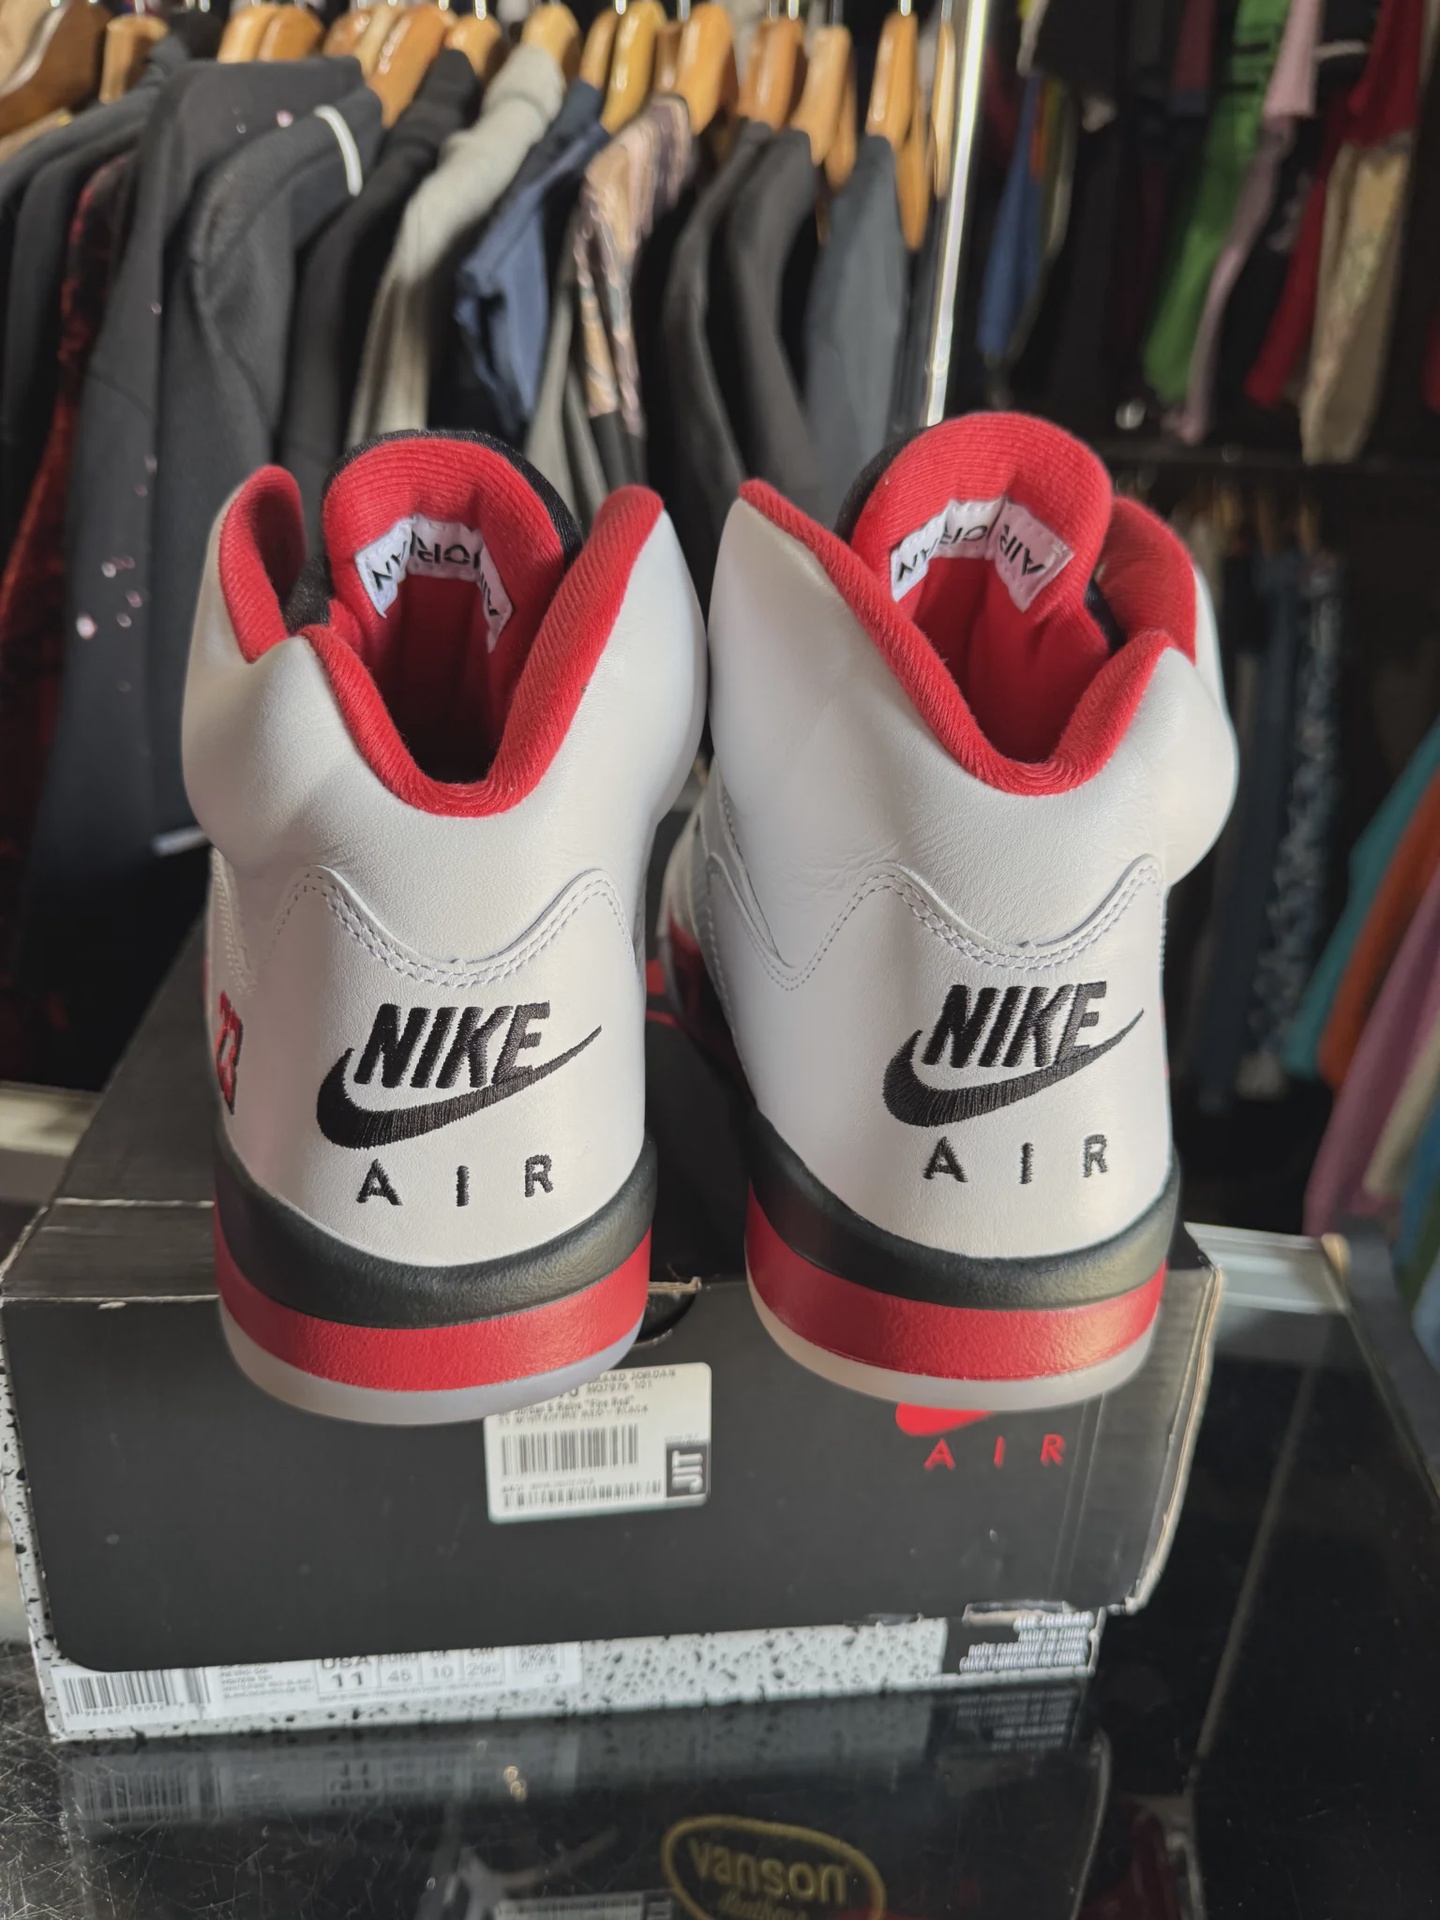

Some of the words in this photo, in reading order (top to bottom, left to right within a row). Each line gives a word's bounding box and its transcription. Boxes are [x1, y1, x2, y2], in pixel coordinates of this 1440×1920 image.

[354, 1000, 550, 1089] NIKE
[921, 981, 1107, 1068] NIKE
[356, 1154, 554, 1207] AIR
[923, 1134, 1109, 1184] AIR
[923, 1433, 1066, 1471] AIR
[331, 1671, 363, 1688] 11
[433, 1664, 455, 1679] 10
